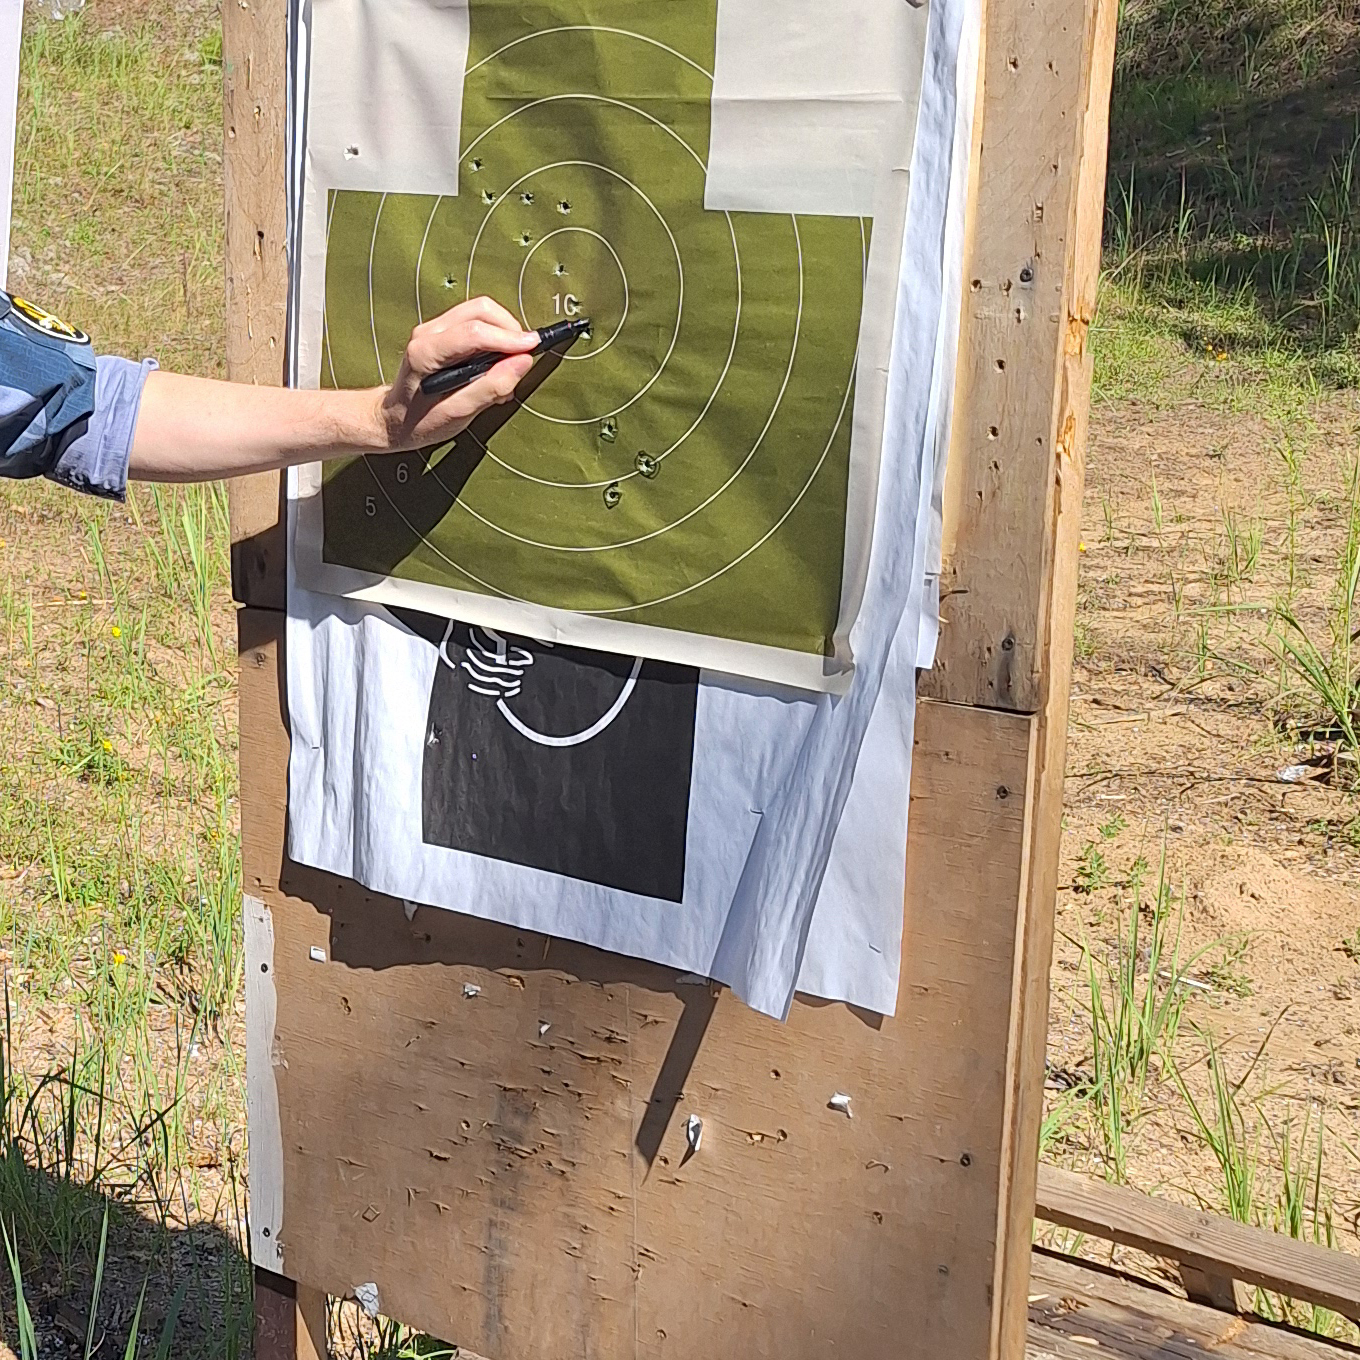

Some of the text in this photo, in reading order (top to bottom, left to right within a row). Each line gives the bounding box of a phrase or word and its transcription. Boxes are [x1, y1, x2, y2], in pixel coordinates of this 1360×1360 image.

[552, 293, 578, 316] 10
[396, 462, 409, 484] 6
[365, 495, 377, 516] 5
